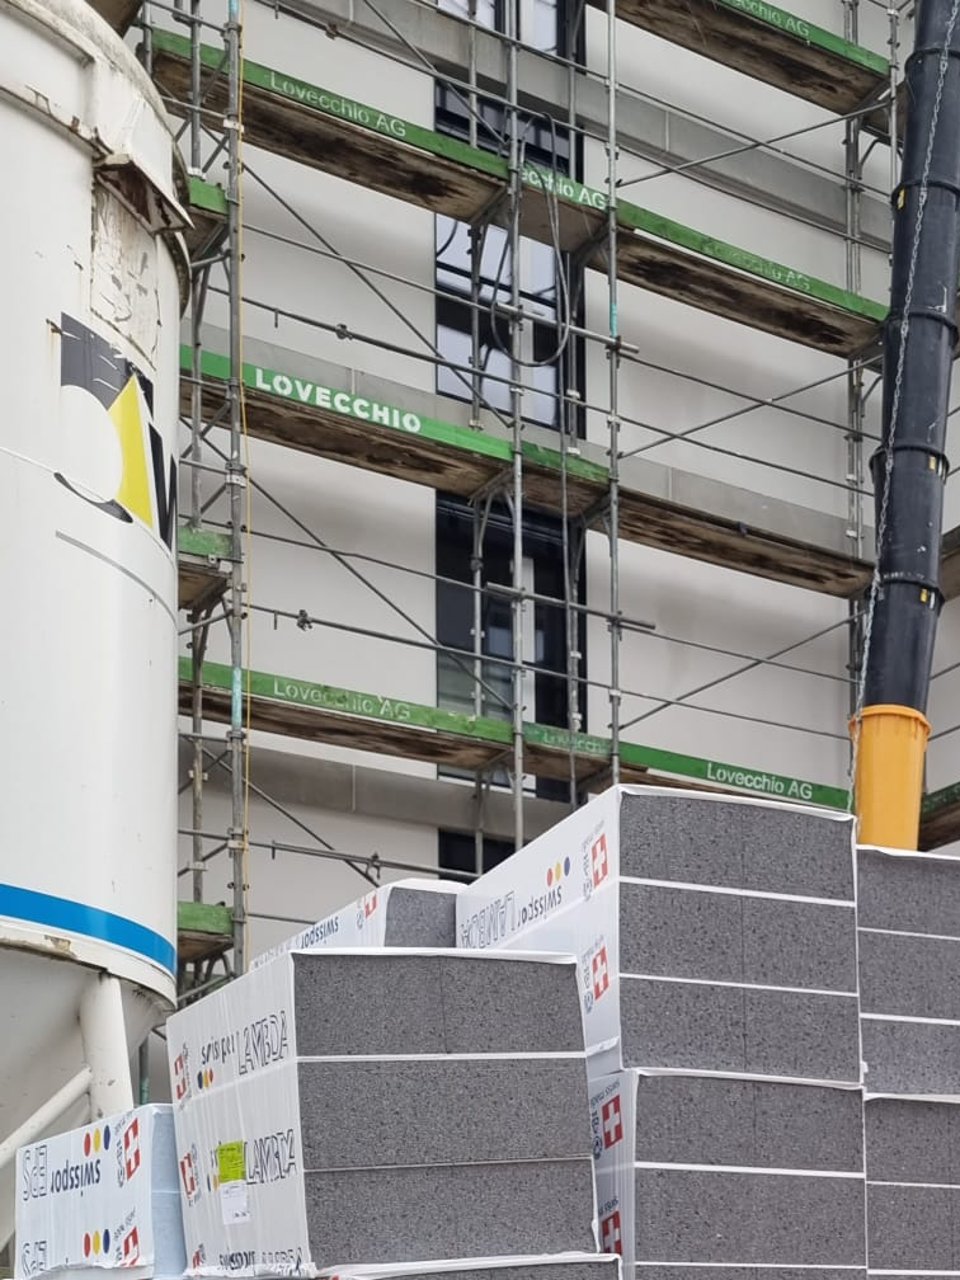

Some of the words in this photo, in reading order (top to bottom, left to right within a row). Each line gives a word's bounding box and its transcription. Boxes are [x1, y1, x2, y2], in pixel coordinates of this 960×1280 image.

[785, 14, 809, 37] AG
[271, 70, 369, 124] Lovecchio
[375, 115, 406, 138] AG
[577, 184, 606, 209] AG
[254, 368, 421, 434] LOVECCHIO
[379, 698, 411, 721] AG
[706, 762, 784, 794] Lovecchio
[787, 780, 812, 801] AG
[301, 915, 339, 949] swisspor
[51, 1159, 101, 1197] swisspor
